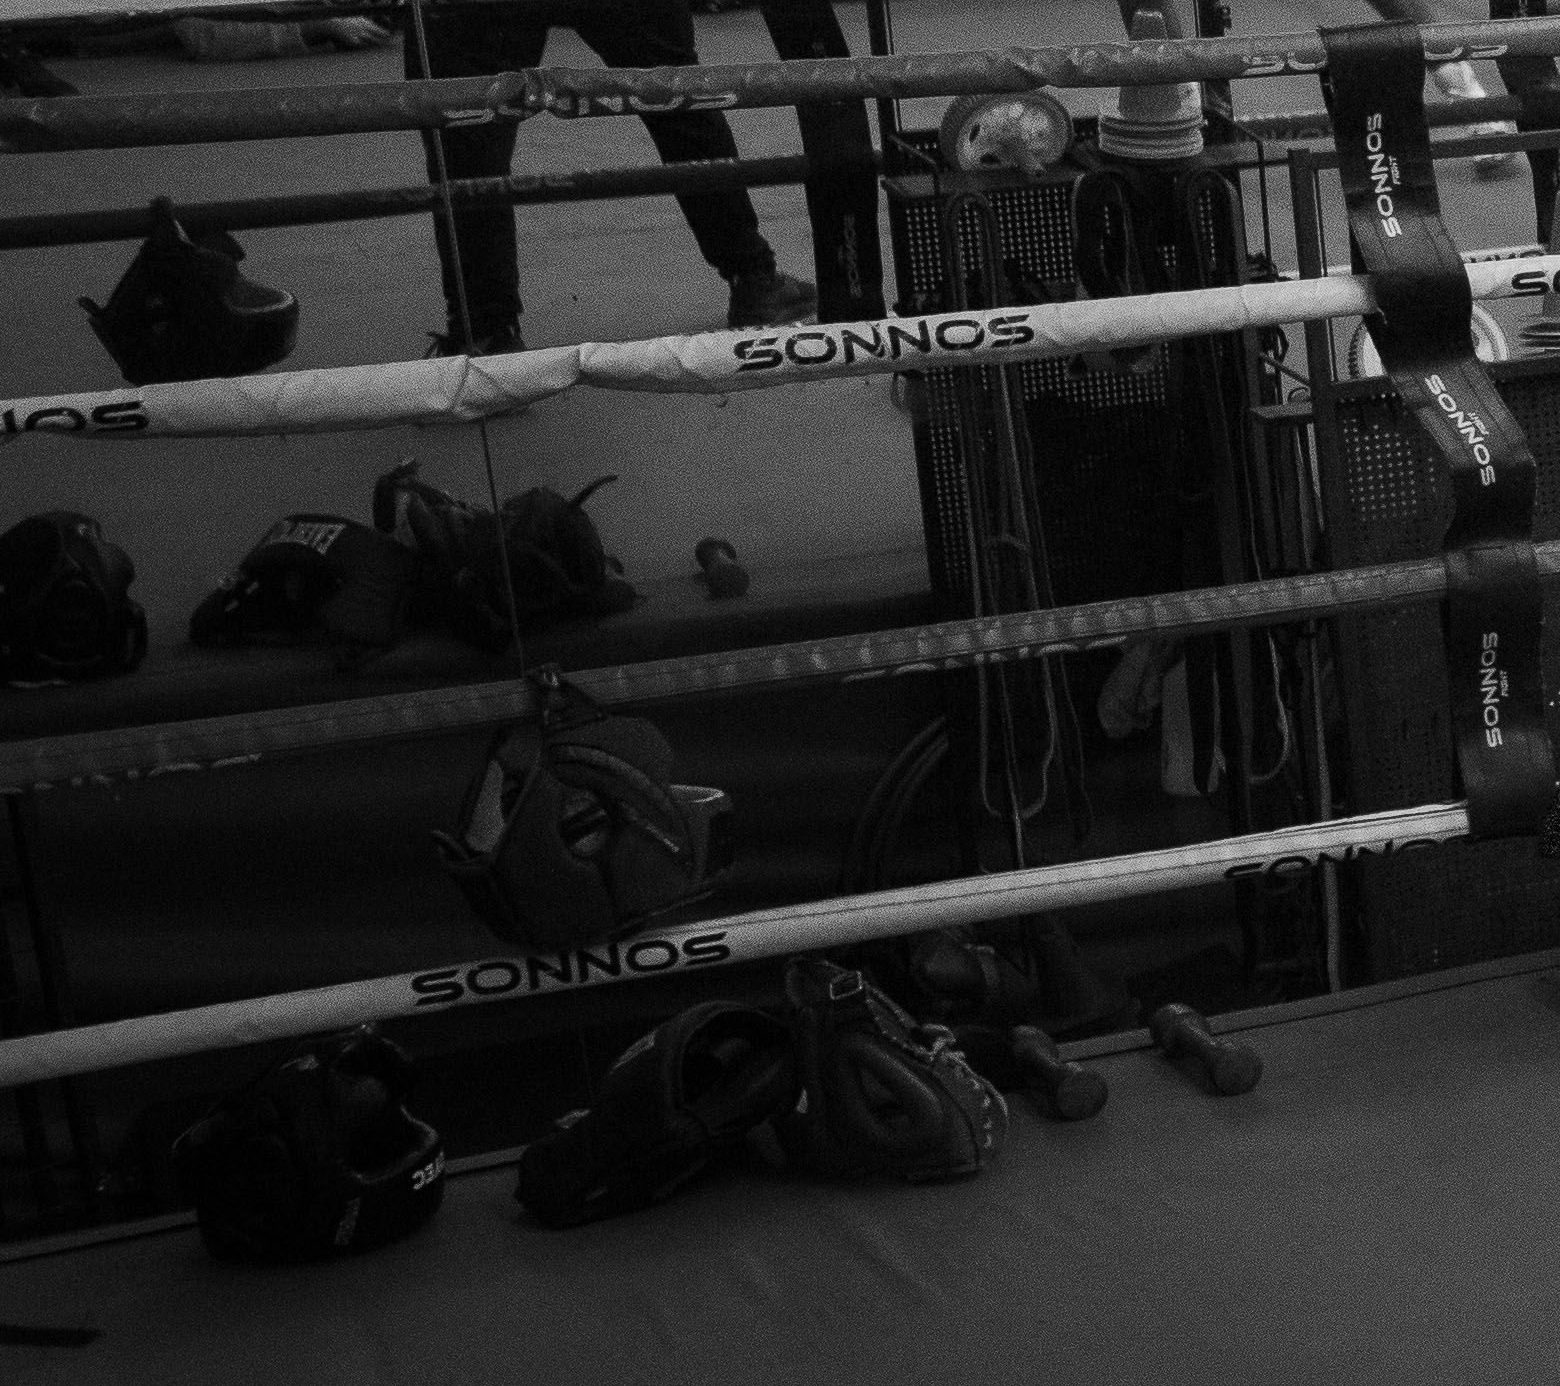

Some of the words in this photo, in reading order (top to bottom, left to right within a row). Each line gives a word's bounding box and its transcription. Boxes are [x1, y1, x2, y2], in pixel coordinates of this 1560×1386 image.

[1366, 112, 1402, 238] SONNOS
[735, 314, 1035, 373] SONNOS
[1424, 373, 1497, 487] SONNOS
[1480, 631, 1504, 748] SONNOS
[410, 930, 733, 1008] SONNOS
